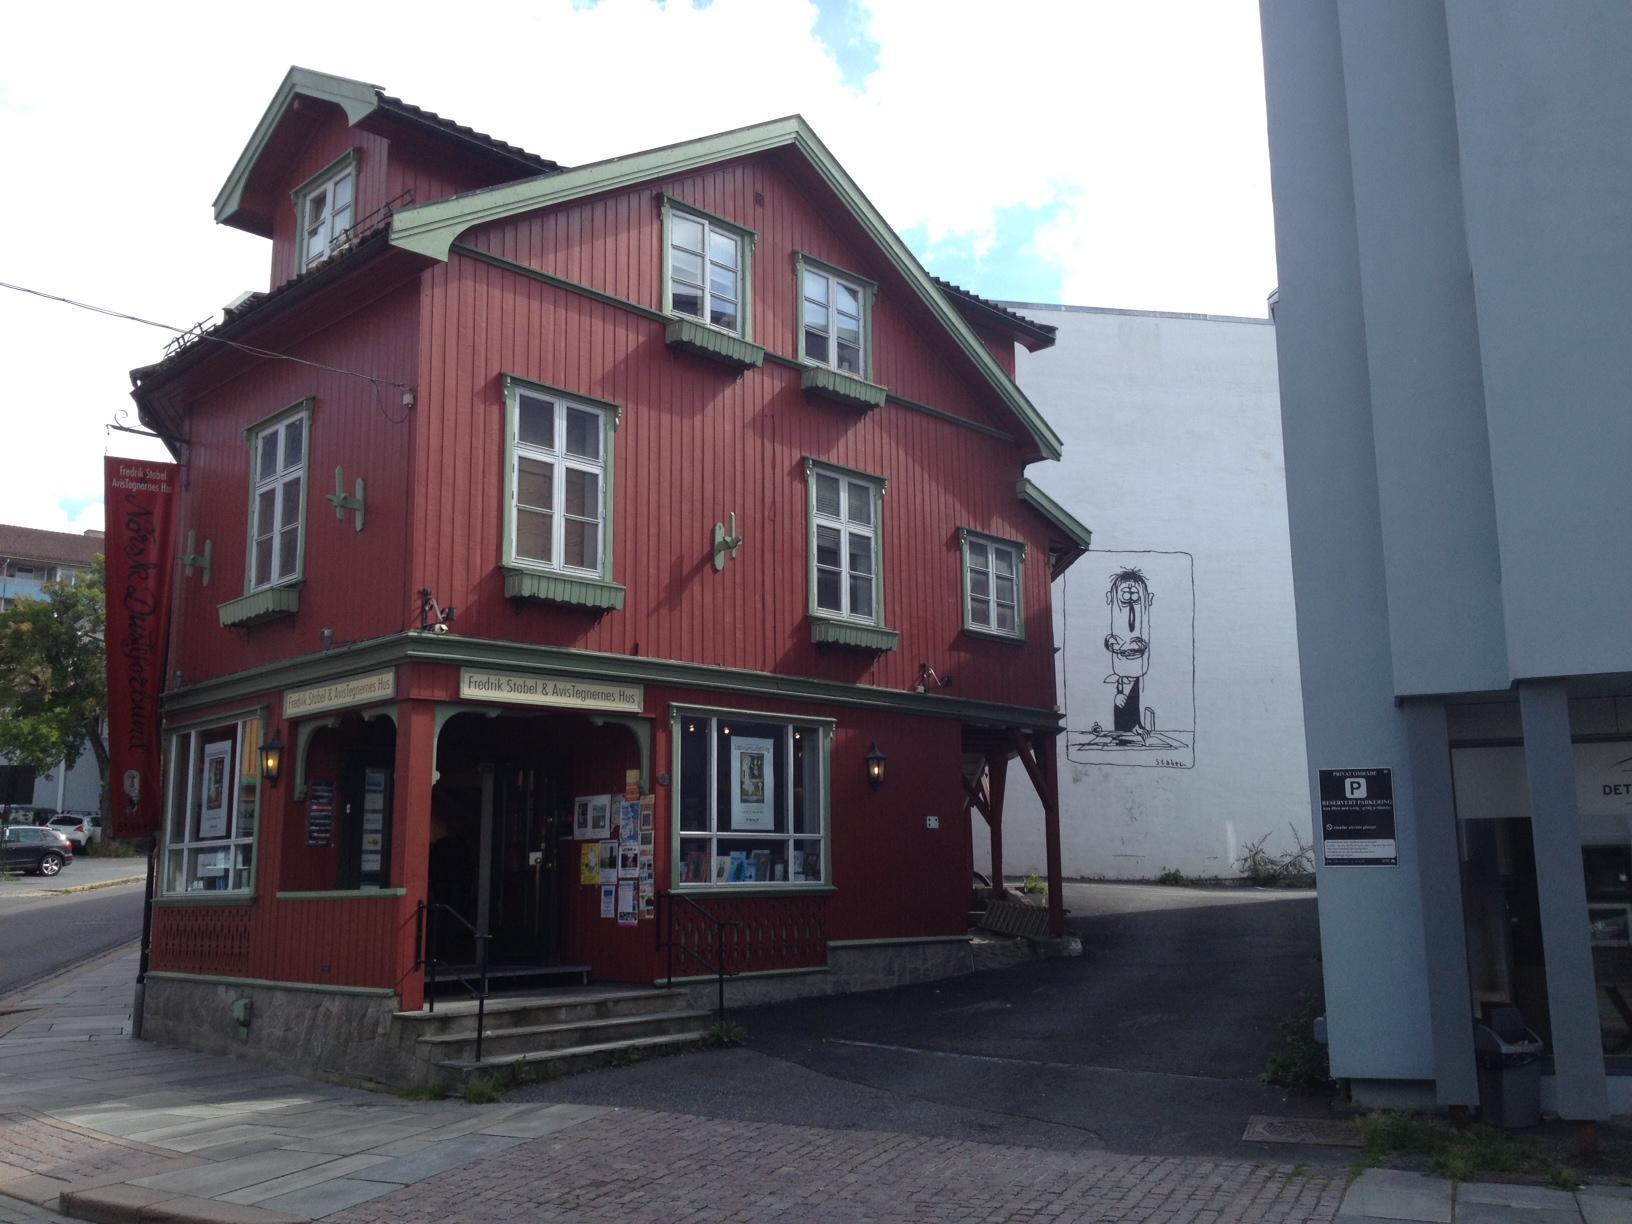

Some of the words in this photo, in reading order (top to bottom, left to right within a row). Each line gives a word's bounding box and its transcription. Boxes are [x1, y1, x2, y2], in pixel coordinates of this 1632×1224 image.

[119, 465, 144, 477] Fredrik
[377, 676, 390, 691] Hus
[468, 675, 503, 692] Fredrik
[506, 679, 538, 695] Stabel
[541, 683, 549, 696] &
[552, 684, 616, 702] AvisTegnernes
[618, 690, 636, 704] Hus
[1350, 781, 1361, 796] P
